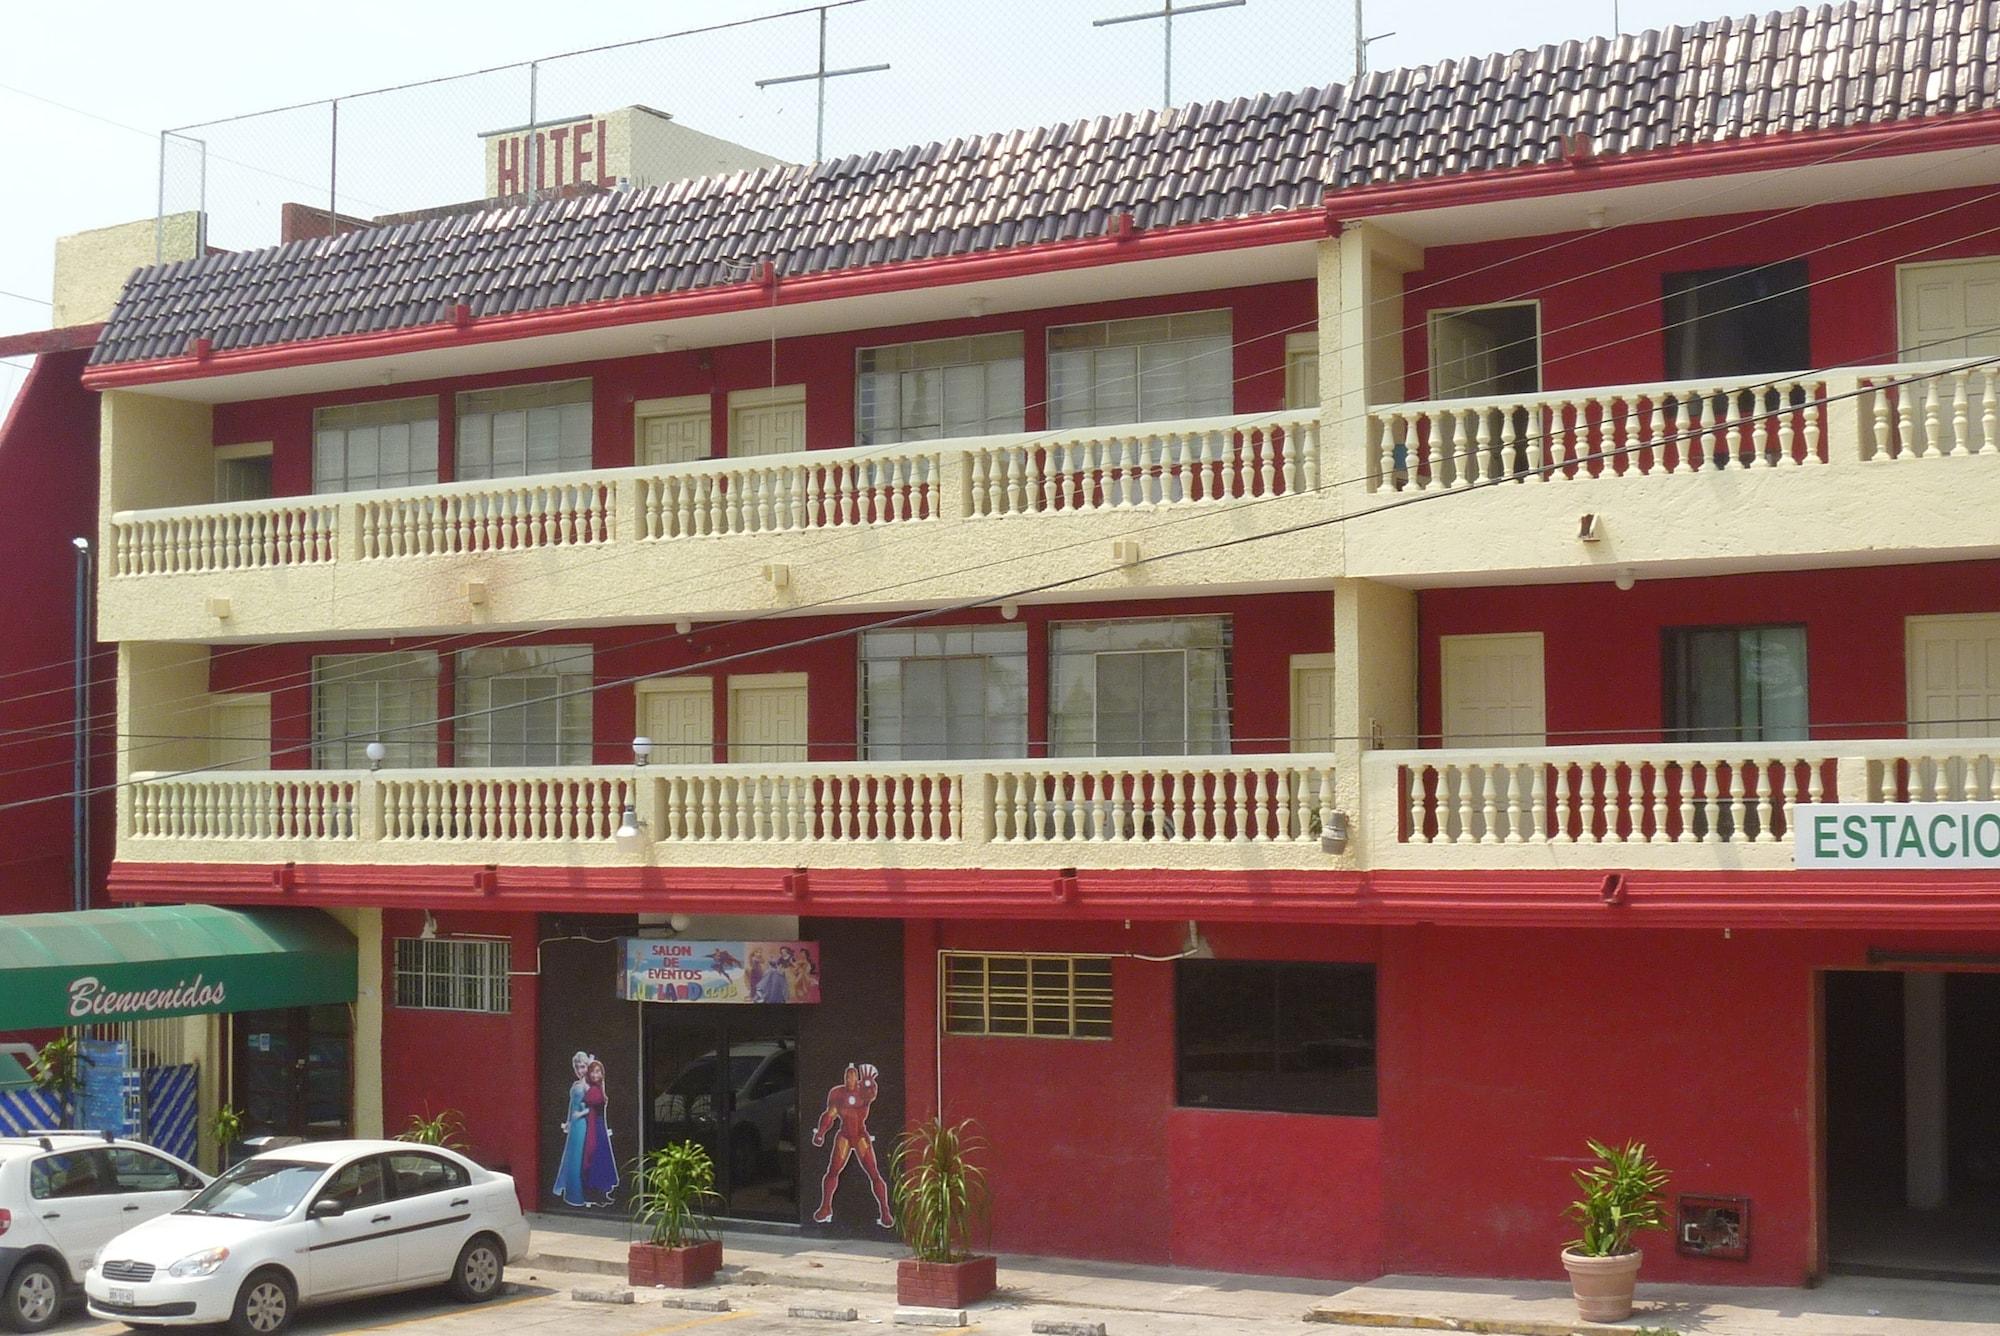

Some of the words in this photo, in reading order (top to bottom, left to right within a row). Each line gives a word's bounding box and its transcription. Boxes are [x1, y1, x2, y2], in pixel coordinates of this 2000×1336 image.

[498, 120, 616, 197] HOTEL
[1814, 813, 2000, 858] ESTACIO
[652, 945, 691, 956] SALON
[664, 957, 680, 968] DE
[648, 968, 702, 980] EVENTOS
[68, 974, 225, 1017] Bienvenidos
